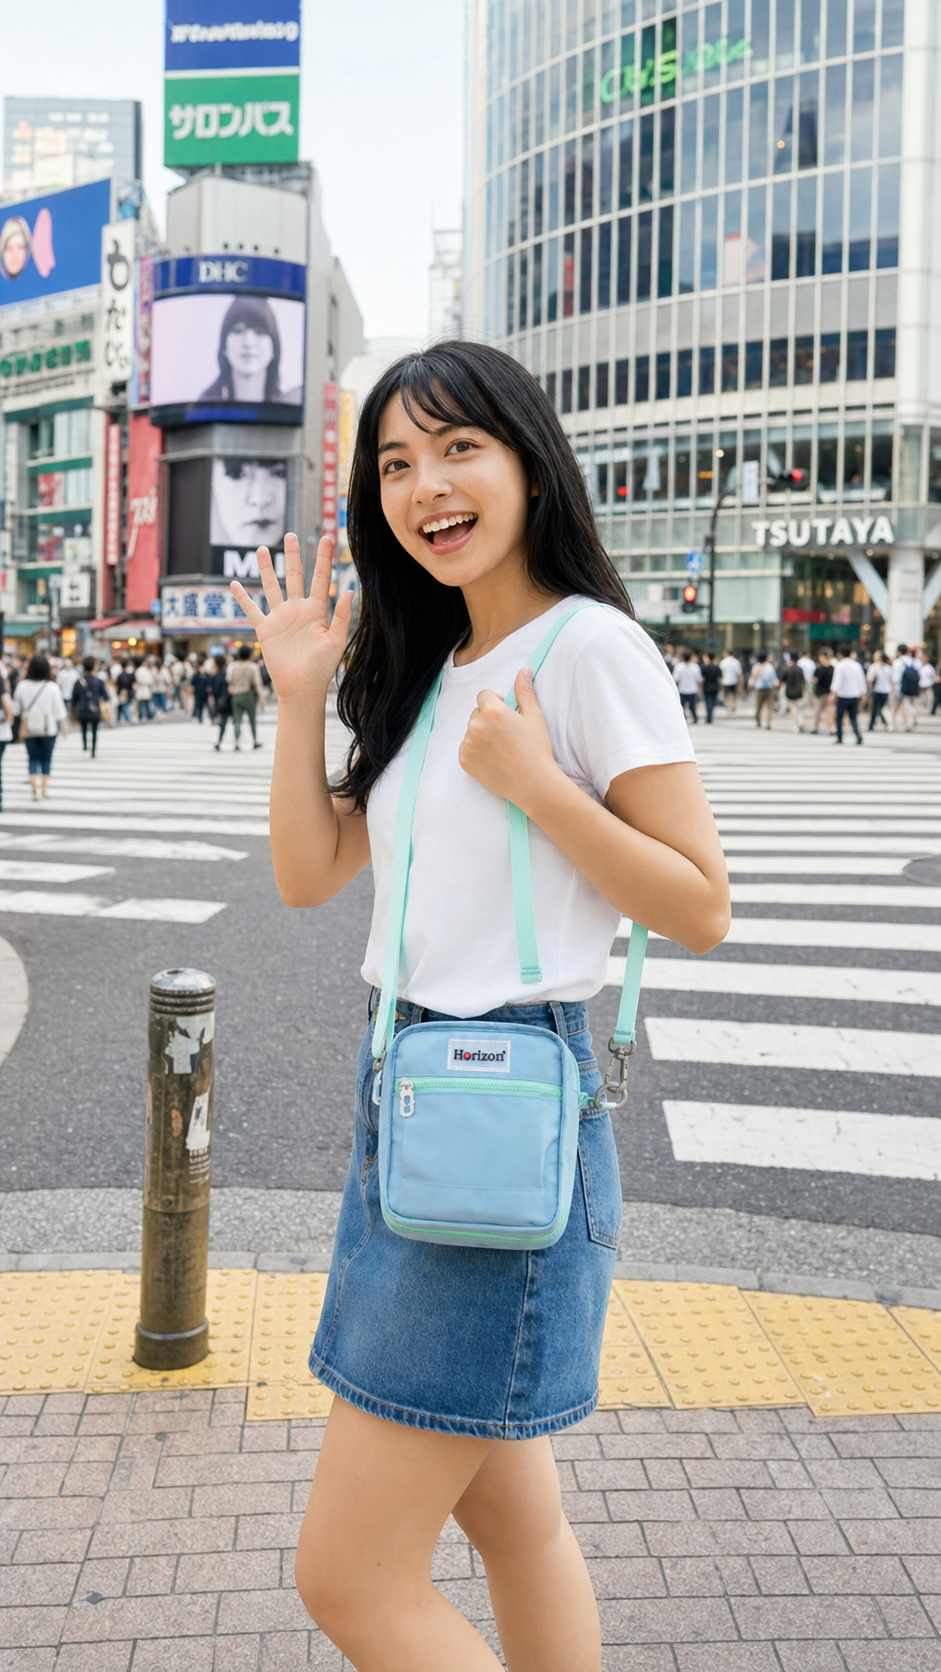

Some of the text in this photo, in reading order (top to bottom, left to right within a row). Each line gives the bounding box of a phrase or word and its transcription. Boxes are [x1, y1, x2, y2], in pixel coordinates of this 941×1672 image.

[169, 101, 294, 140] サロンパス
[199, 261, 249, 283] DHC
[751, 516, 894, 547] TSUTAYA
[453, 1049, 506, 1061] Horizon
